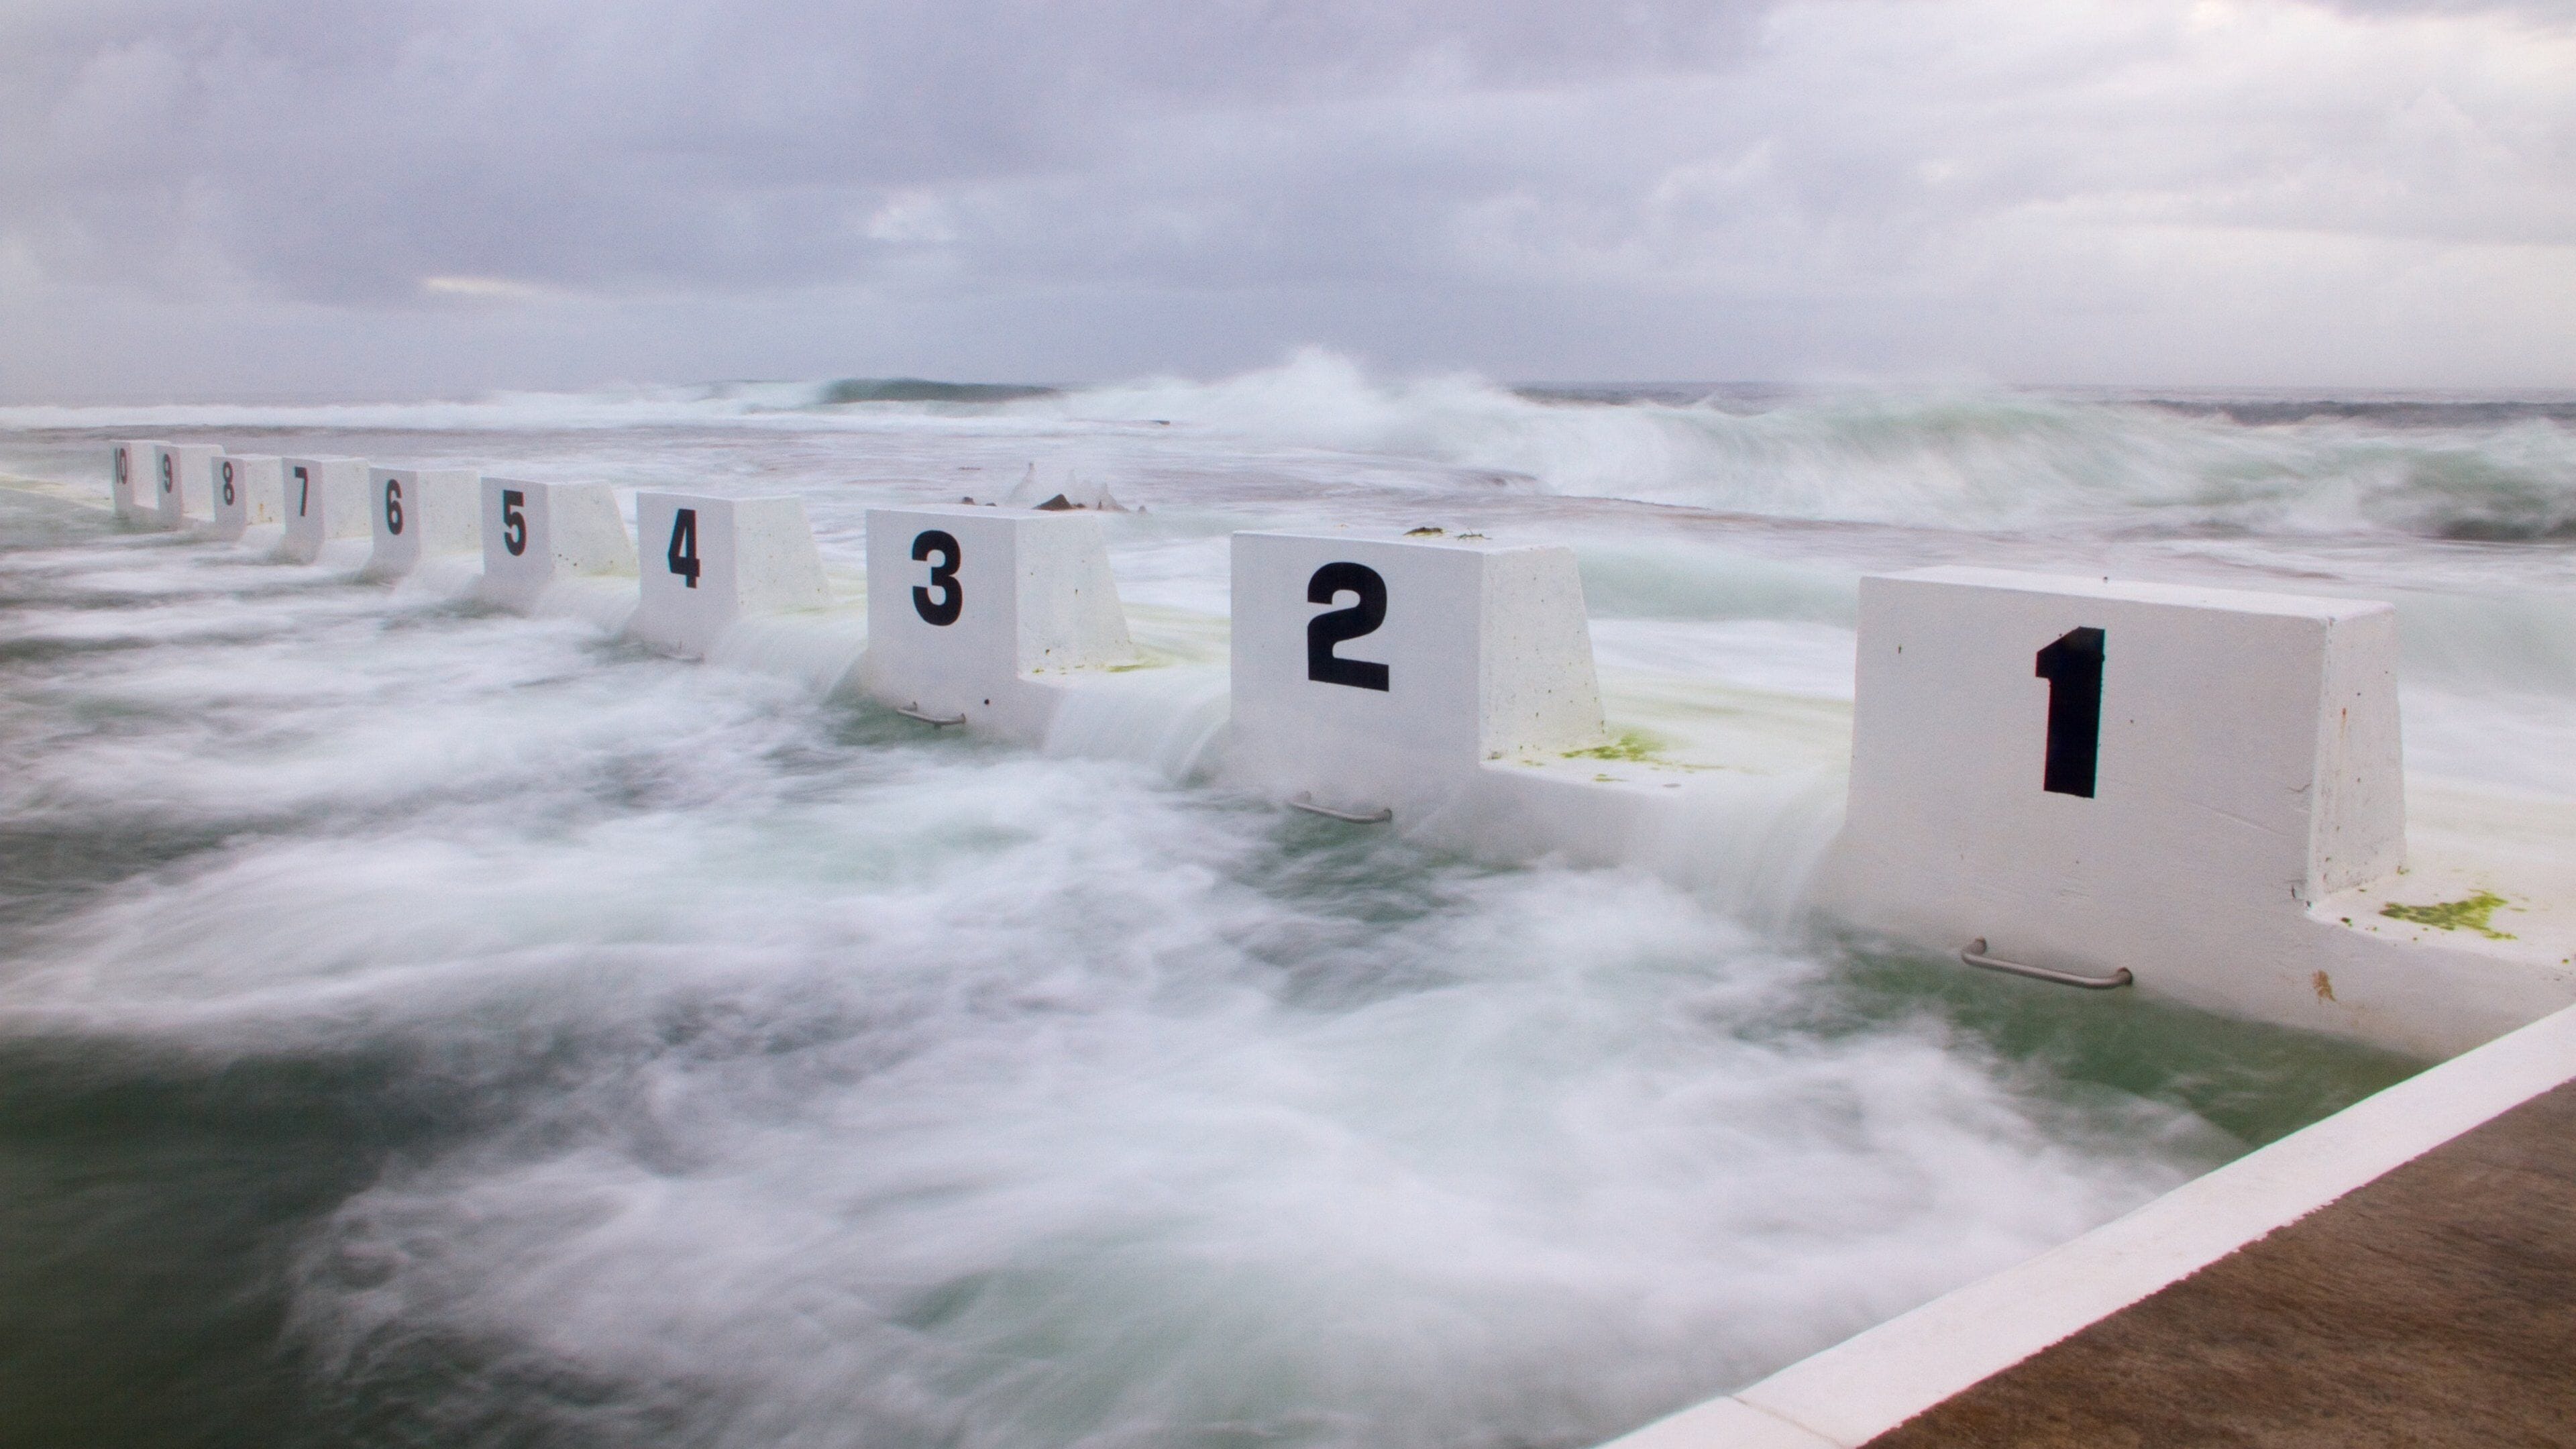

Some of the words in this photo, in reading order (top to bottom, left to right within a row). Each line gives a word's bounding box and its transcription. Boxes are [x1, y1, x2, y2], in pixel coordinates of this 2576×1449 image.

[114, 447, 128, 485] 10
[162, 453, 173, 494] 9
[222, 461, 235, 506] 8
[294, 466, 309, 517] 7
[385, 478, 403, 535] 6
[502, 489, 527, 556] 5
[667, 508, 700, 588] 4
[912, 529, 962, 626] 3
[1307, 562, 1389, 692] 2
[2036, 627, 2105, 798] 1
